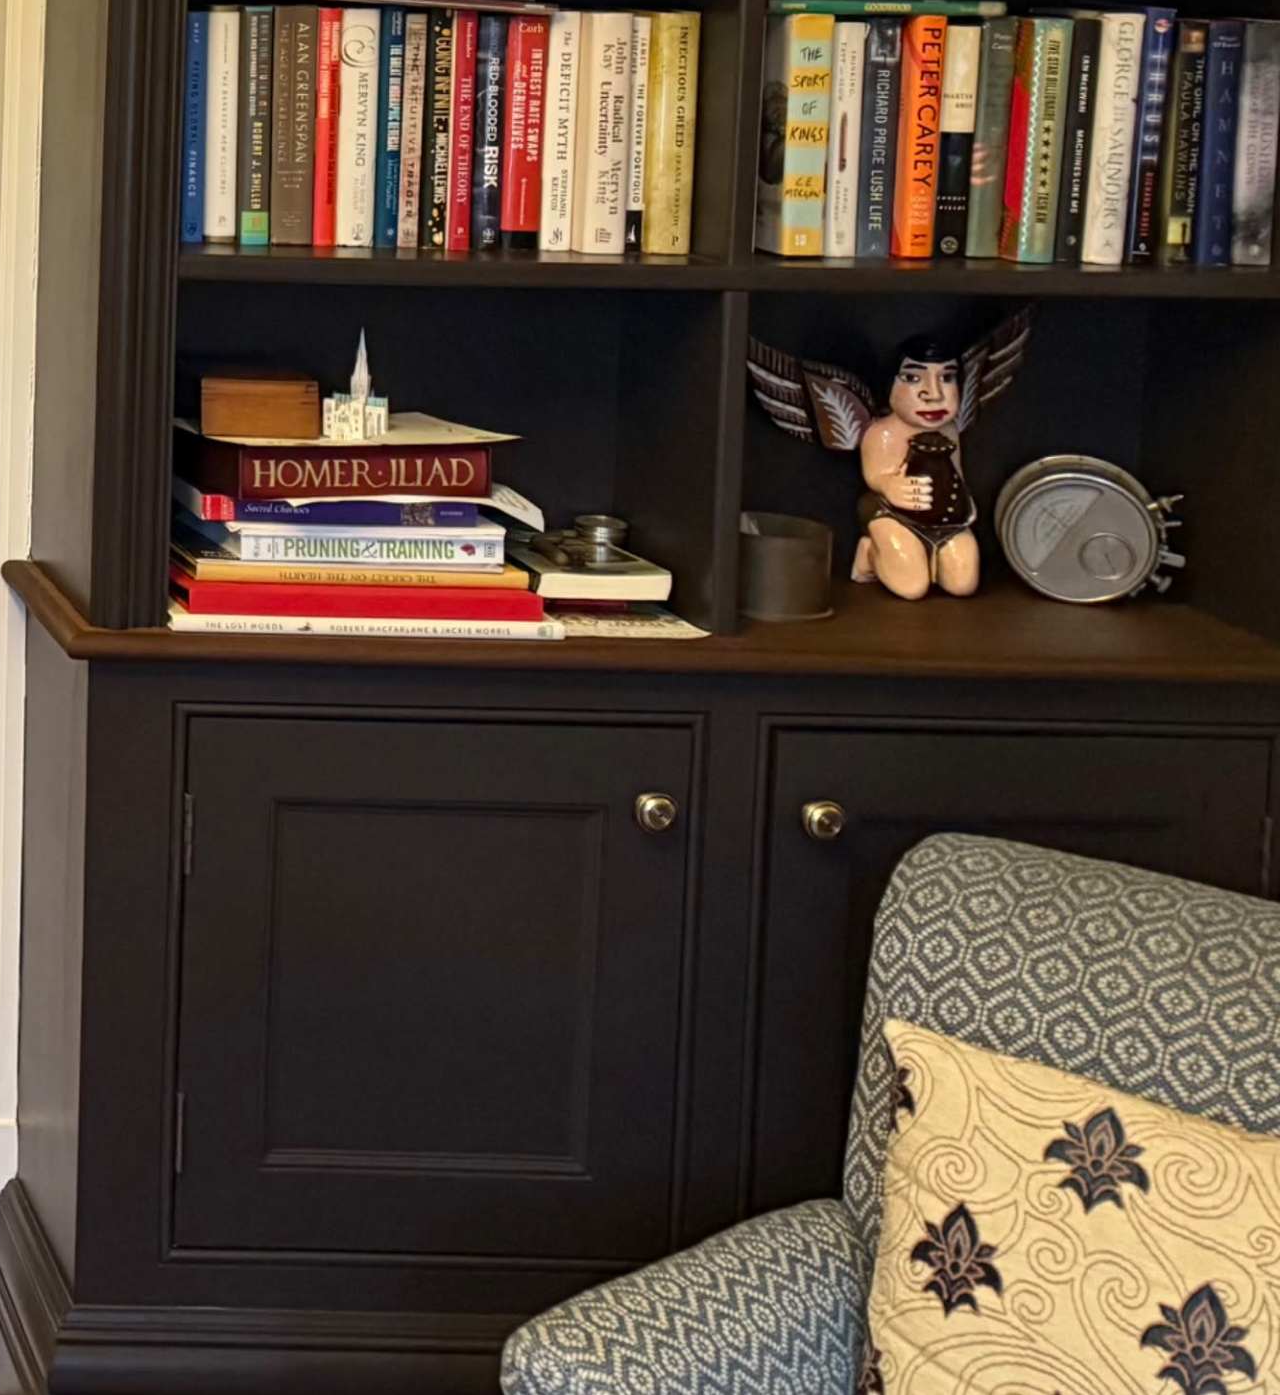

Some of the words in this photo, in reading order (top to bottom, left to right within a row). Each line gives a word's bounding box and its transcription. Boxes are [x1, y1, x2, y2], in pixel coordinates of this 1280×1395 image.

[296, 23, 310, 64] ALAN
[615, 37, 626, 75] John
[677, 26, 689, 102] INFECTIOUS
[918, 27, 942, 99] PETER
[1113, 21, 1136, 101] GEORGE
[460, 76, 472, 101] THE
[530, 49, 543, 97] INTEREST
[558, 52, 571, 113] DEFICIT
[637, 84, 645, 102] THE
[295, 70, 309, 163] GREENSPAN
[356, 72, 369, 127] MERVYN
[460, 105, 471, 131] END
[487, 56, 498, 142] RED-BLOODED
[511, 81, 524, 150] DERIVATIVES
[530, 100, 540, 125] RATE
[874, 70, 891, 124] RICHARD
[1142, 50, 1168, 164] THRUST
[251, 122, 263, 156] ROBERT
[556, 118, 569, 160] MYTH
[594, 81, 612, 157] Uncertainty
[612, 94, 624, 143] Radical
[635, 104, 645, 146] FOREVER
[675, 106, 686, 149] GREED
[355, 133, 366, 167] KING
[459, 135, 470, 150] OF
[527, 128, 539, 162] SWAPS
[872, 127, 889, 165] PRICE
[912, 104, 936, 189] CAREY
[1072, 129, 1085, 177] MACHINES
[457, 155, 469, 205] THEORY
[483, 146, 499, 188] RISK
[608, 160, 622, 215] Mervyn
[632, 150, 642, 204] PORTFOLIO
[869, 169, 886, 201] LUSH
[1071, 178, 1080, 198] LIKE
[1102, 127, 1124, 229] SAUNDERS
[251, 173, 261, 209] SHILLER
[868, 205, 884, 231] LIFE
[252, 458, 372, 490] HOMER
[389, 456, 476, 488] ILIAD
[283, 536, 361, 560] PRUNING
[377, 536, 456, 560] TRAINING
